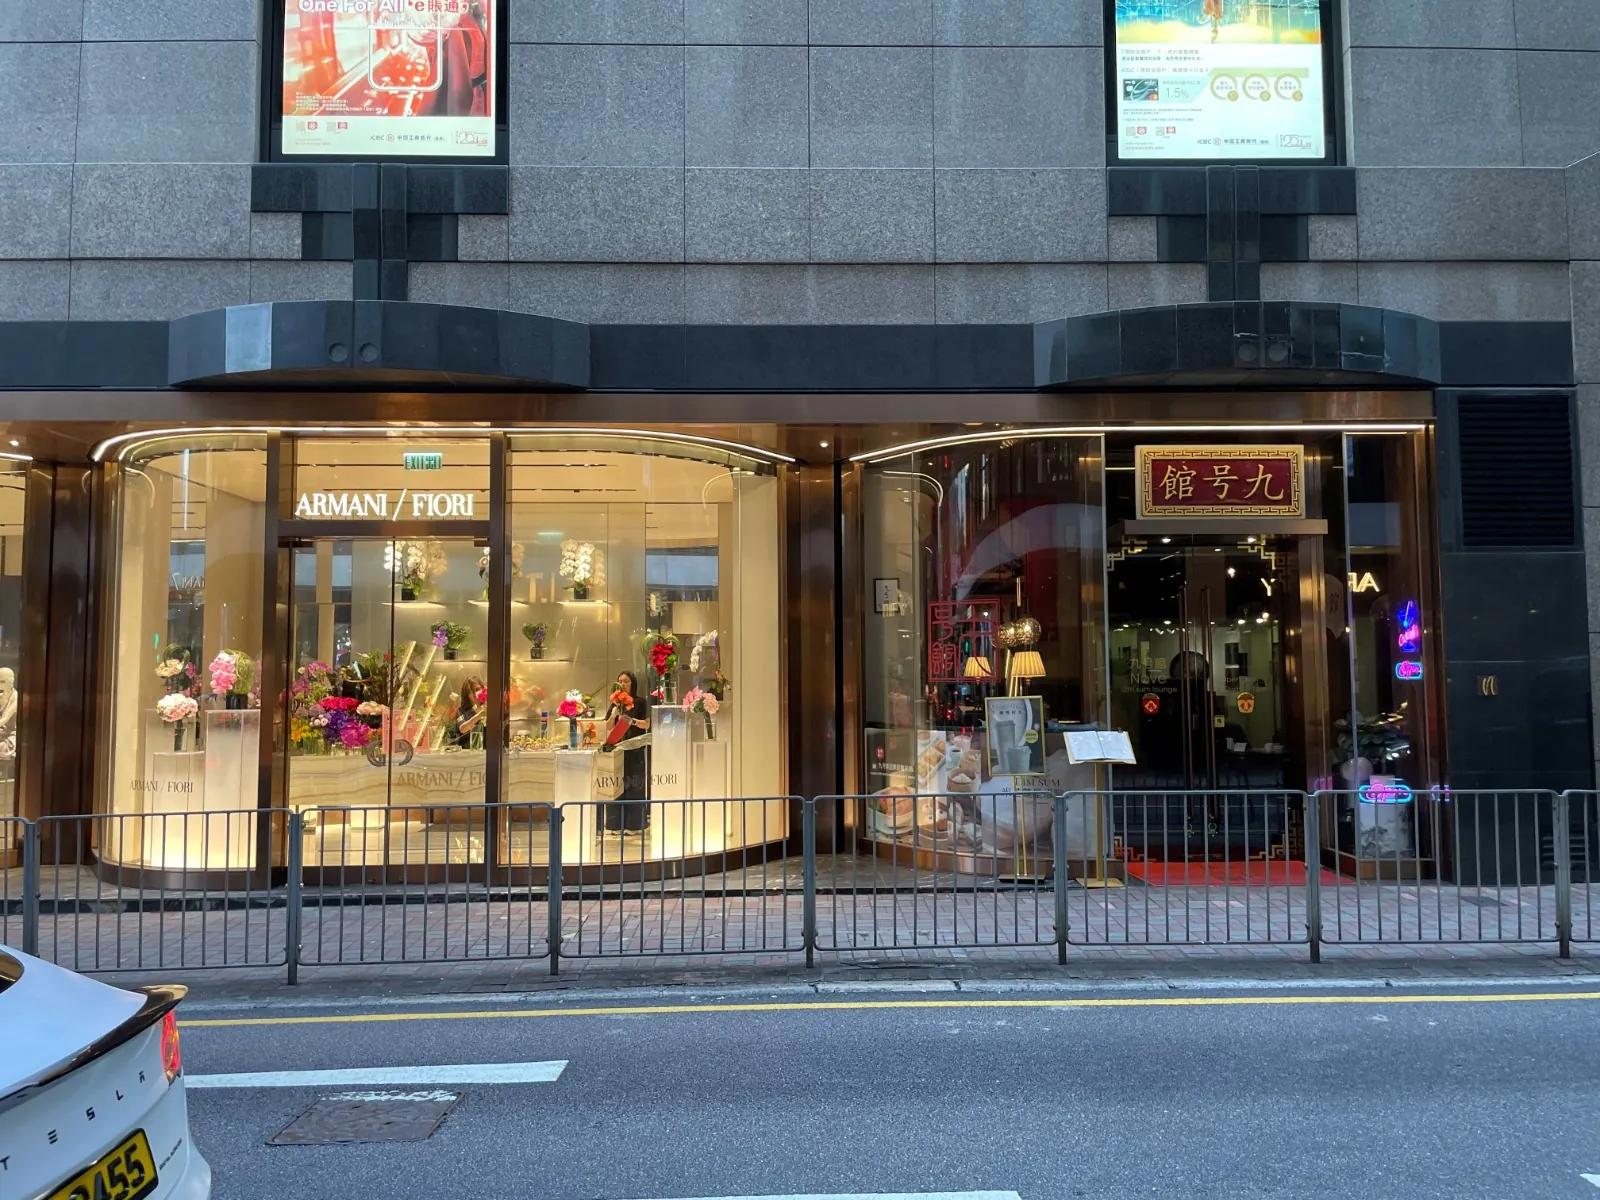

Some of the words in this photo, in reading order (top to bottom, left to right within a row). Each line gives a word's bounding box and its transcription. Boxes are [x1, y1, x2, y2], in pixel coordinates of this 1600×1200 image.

[298, 0, 338, 12] One
[342, 0, 376, 12] For
[378, 0, 405, 12] All
[405, 455, 424, 470] EXIT
[425, 455, 442, 470] 出口
[294, 493, 388, 516] ARMANI
[411, 493, 474, 516] FIORI
[397, 772, 454, 786] ARMANI
[129, 780, 158, 791] ARMANI
[168, 781, 193, 793] FIORI
